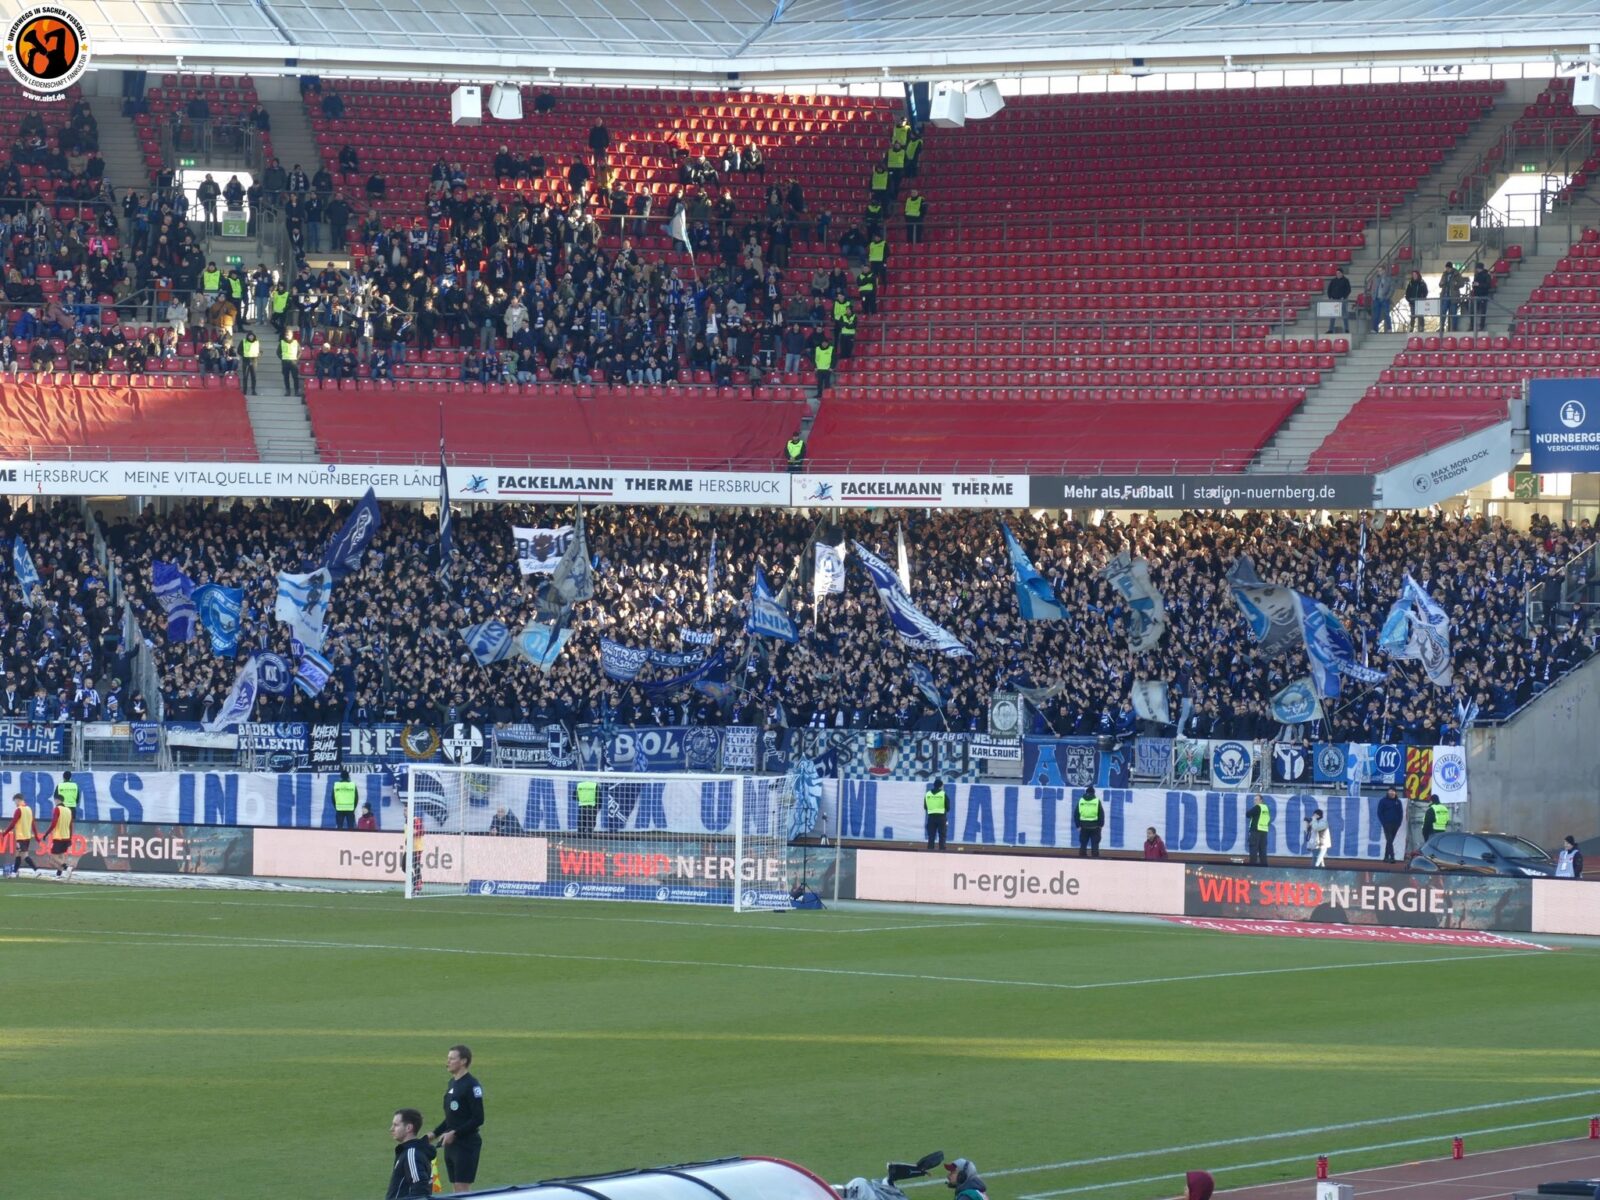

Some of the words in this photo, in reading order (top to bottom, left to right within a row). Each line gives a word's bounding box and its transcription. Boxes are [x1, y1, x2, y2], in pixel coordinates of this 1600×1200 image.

[1453, 229, 1464, 238] 26
[1547, 444, 1599, 452] VERSICHERUNG
[1431, 466, 1449, 478] MAX
[1450, 449, 1489, 470] MORLOCK
[24, 469, 109, 483] HERSBRUCK
[125, 471, 169, 483] MEINE
[174, 472, 272, 486] VITALQUELLE
[277, 473, 293, 484] IM
[298, 470, 398, 485] NÜRNBERGER
[498, 475, 613, 490] FACKELMANN
[1433, 465, 1468, 485] STADION
[625, 478, 692, 491] THERME
[699, 479, 780, 493] HERSBRUCK
[841, 482, 942, 495] FACKELMANN
[952, 482, 1013, 495] THERME
[1064, 484, 1097, 498] Mehr
[1101, 484, 1121, 498] als
[1124, 484, 1173, 499] Fußball
[1193, 484, 1336, 503] stadion-nuernberg.de
[310, 750, 337, 763] BADEN
[971, 747, 1019, 758] KARLSRUHE
[1068, 748, 1094, 756] ULTRAS
[1139, 744, 1170, 758] UNS
[1028, 744, 1066, 786] A
[1378, 751, 1397, 768] KSC
[178, 773, 239, 825] IN
[559, 850, 606, 876] WIR
[613, 853, 670, 878] SIND
[953, 868, 1080, 899] n-ergie.de
[1199, 878, 1250, 905] WIR
[1259, 880, 1323, 908] SIND
